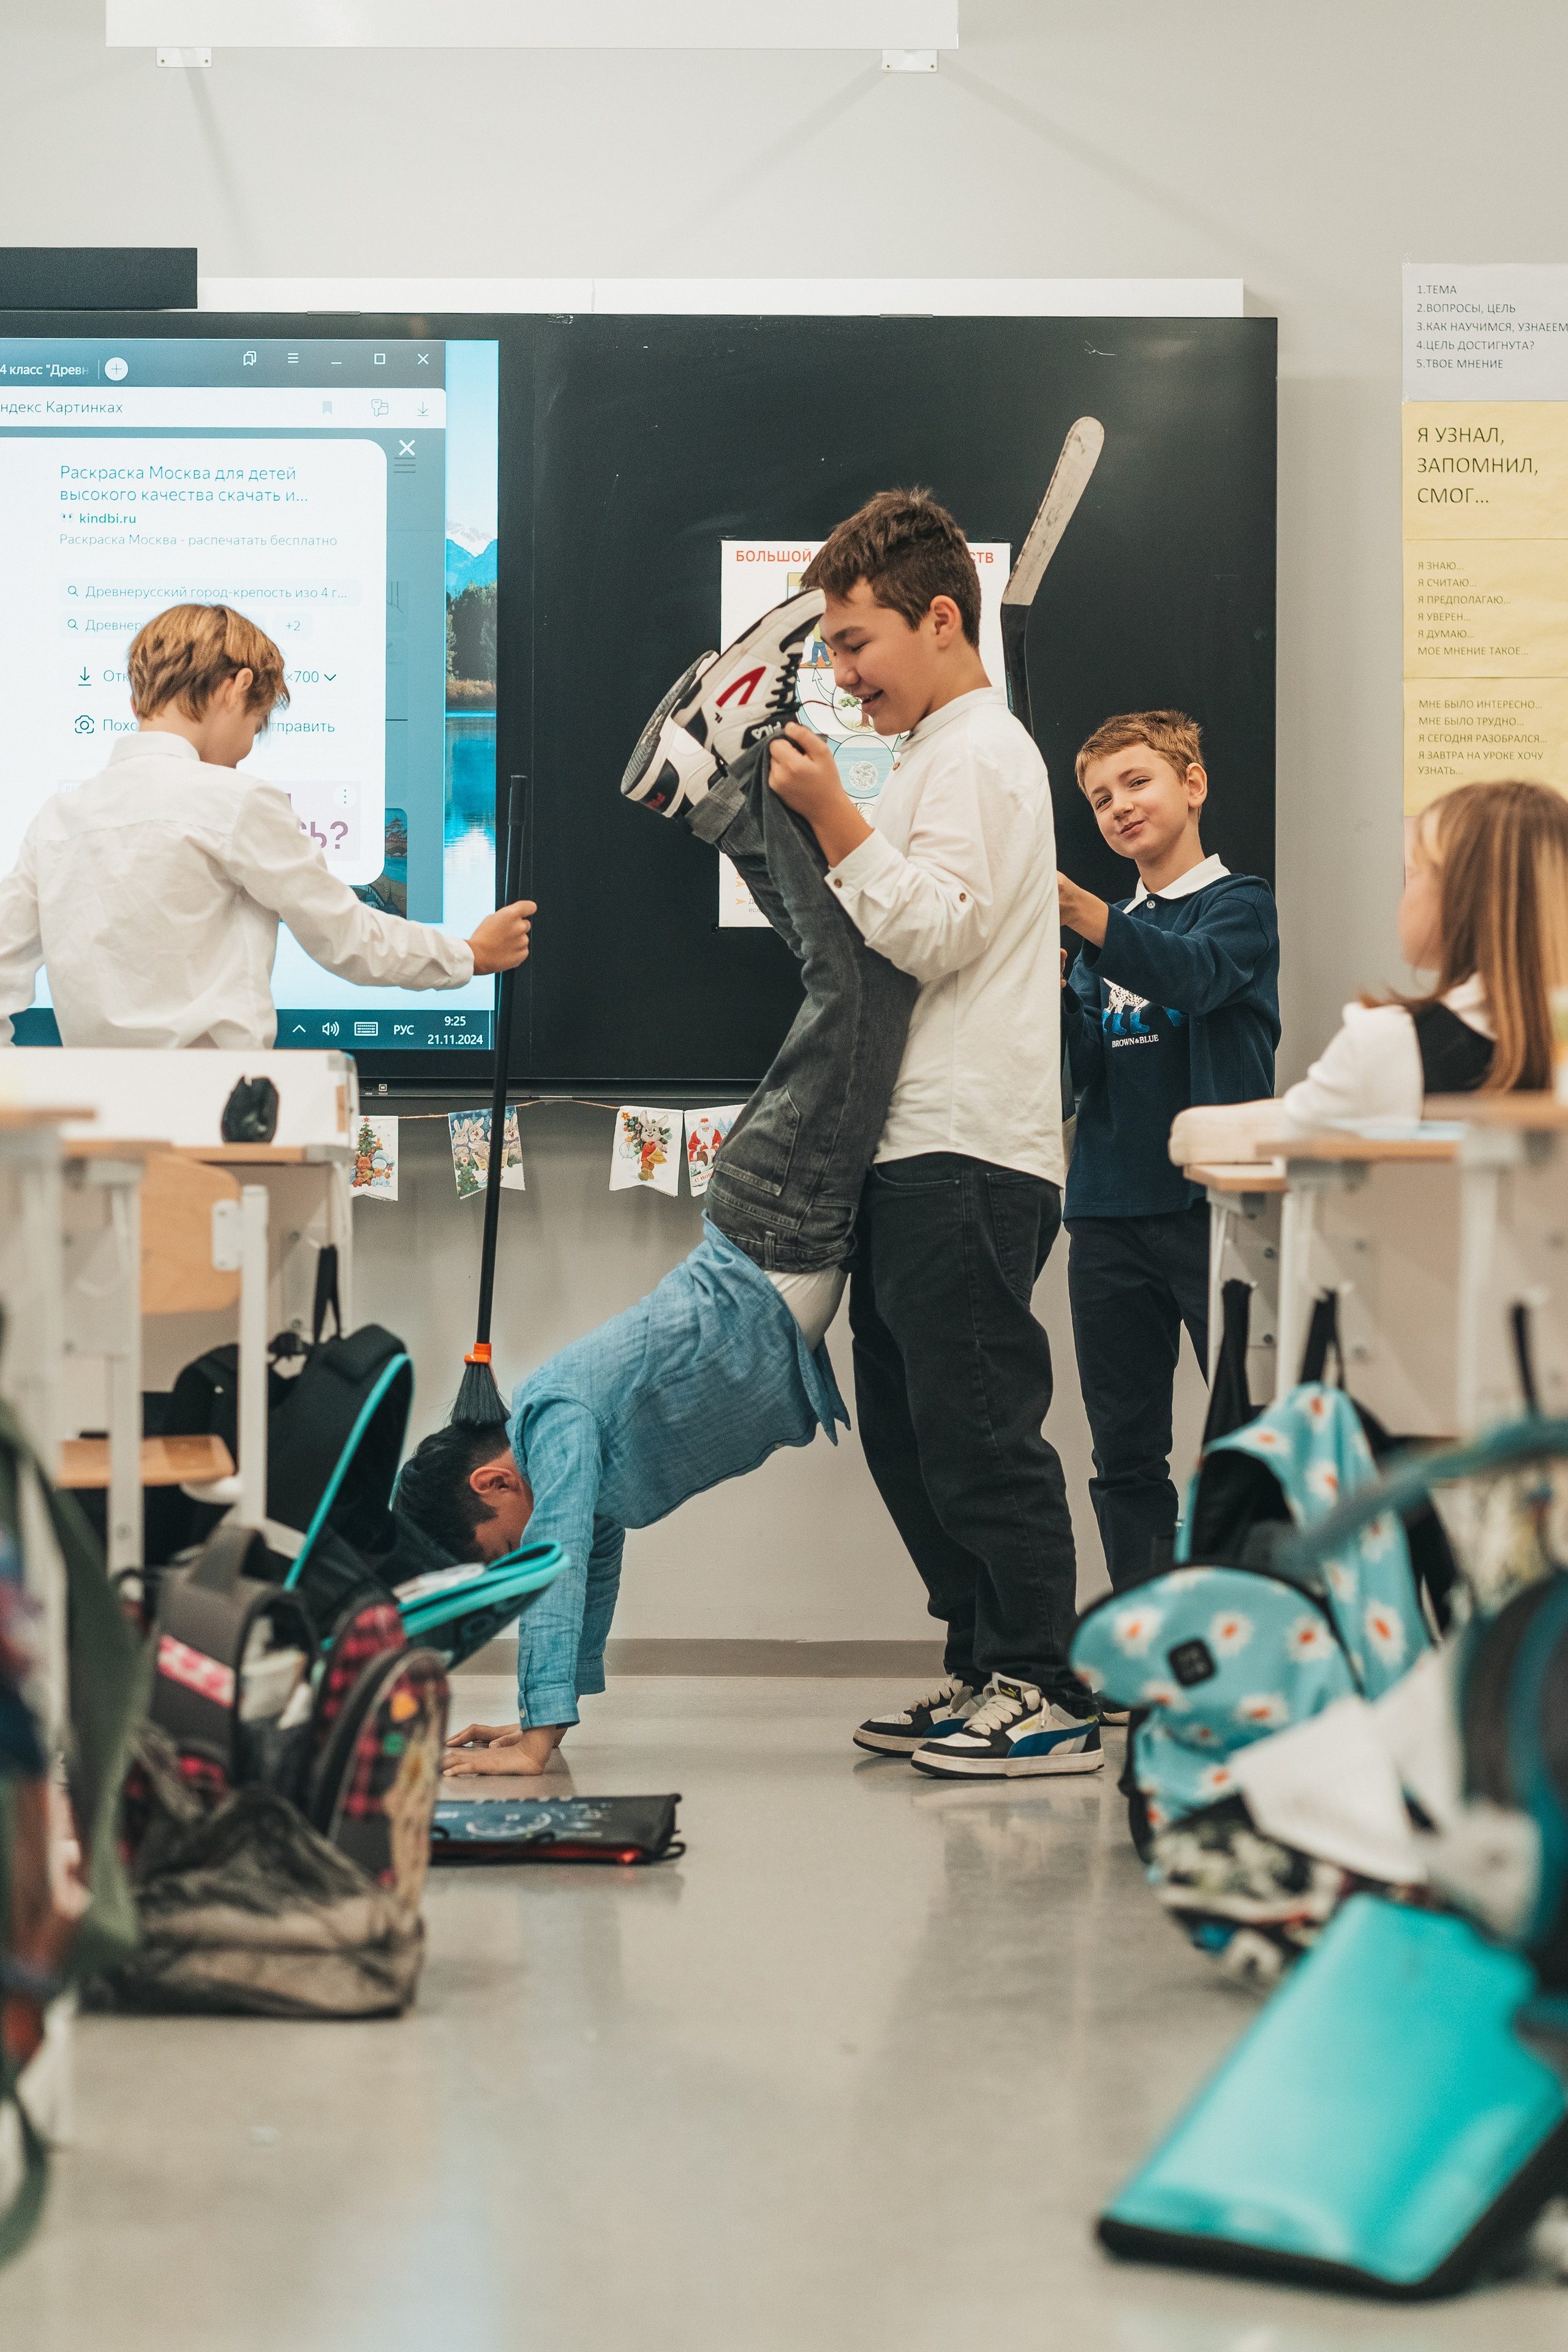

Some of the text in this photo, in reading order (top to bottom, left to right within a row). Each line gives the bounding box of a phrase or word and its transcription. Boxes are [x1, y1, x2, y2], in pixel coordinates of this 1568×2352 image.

[1418, 285, 1457, 294] 1.ТЕМА
[1417, 304, 1515, 314] 2.ВОПРОСЫ, ЦЕЛЬ
[1417, 322, 1447, 331] 3.КАК
[1451, 323, 1514, 333] НАУЧИМСЯ,
[1417, 341, 1534, 352] 4.ЦЕЛЬ ДОСТИГНУТА?
[1417, 359, 1502, 368] 5.ТВОЕ МНЕНИЕ
[9, 365, 43, 375] класс
[1, 401, 122, 415] ндекс Картинках
[1418, 428, 1504, 445] Я УЗНАЛ,
[1418, 458, 1537, 475] ЗАПОМНИЛ,
[61, 466, 295, 481] Раскраска Москва для детей
[61, 491, 309, 502] высокого качества скачать и...
[1418, 488, 1489, 503] СМОГ...
[80, 513, 136, 523] kindbi.ru
[60, 534, 125, 546] Раскраска
[129, 534, 176, 545] Москва
[189, 537, 266, 547] распечатать
[270, 535, 337, 546] бесплатно
[736, 548, 811, 562] БОЛЬШОЙ
[85, 586, 186, 599] Древнерусский
[191, 589, 292, 599] город-крепость
[321, 587, 328, 598] 4
[85, 619, 145, 632] Древнер
[287, 620, 300, 631] +2
[1444, 700, 1474, 709] БЫЛО
[1444, 717, 1474, 726] БЫЛО
[271, 723, 335, 735] тправить
[1428, 734, 1472, 744] СЕГОДНЯ
[1427, 751, 1464, 760] ЗАВТРА
[1483, 752, 1514, 760] УРОКЕ
[1518, 752, 1543, 760] ХОЧУ
[444, 1016, 466, 1026] 9:25
[393, 1025, 415, 1035] РУС
[428, 1035, 483, 1045] 21.11.2024
[1112, 1035, 1159, 1048] BROWN&BLUE
